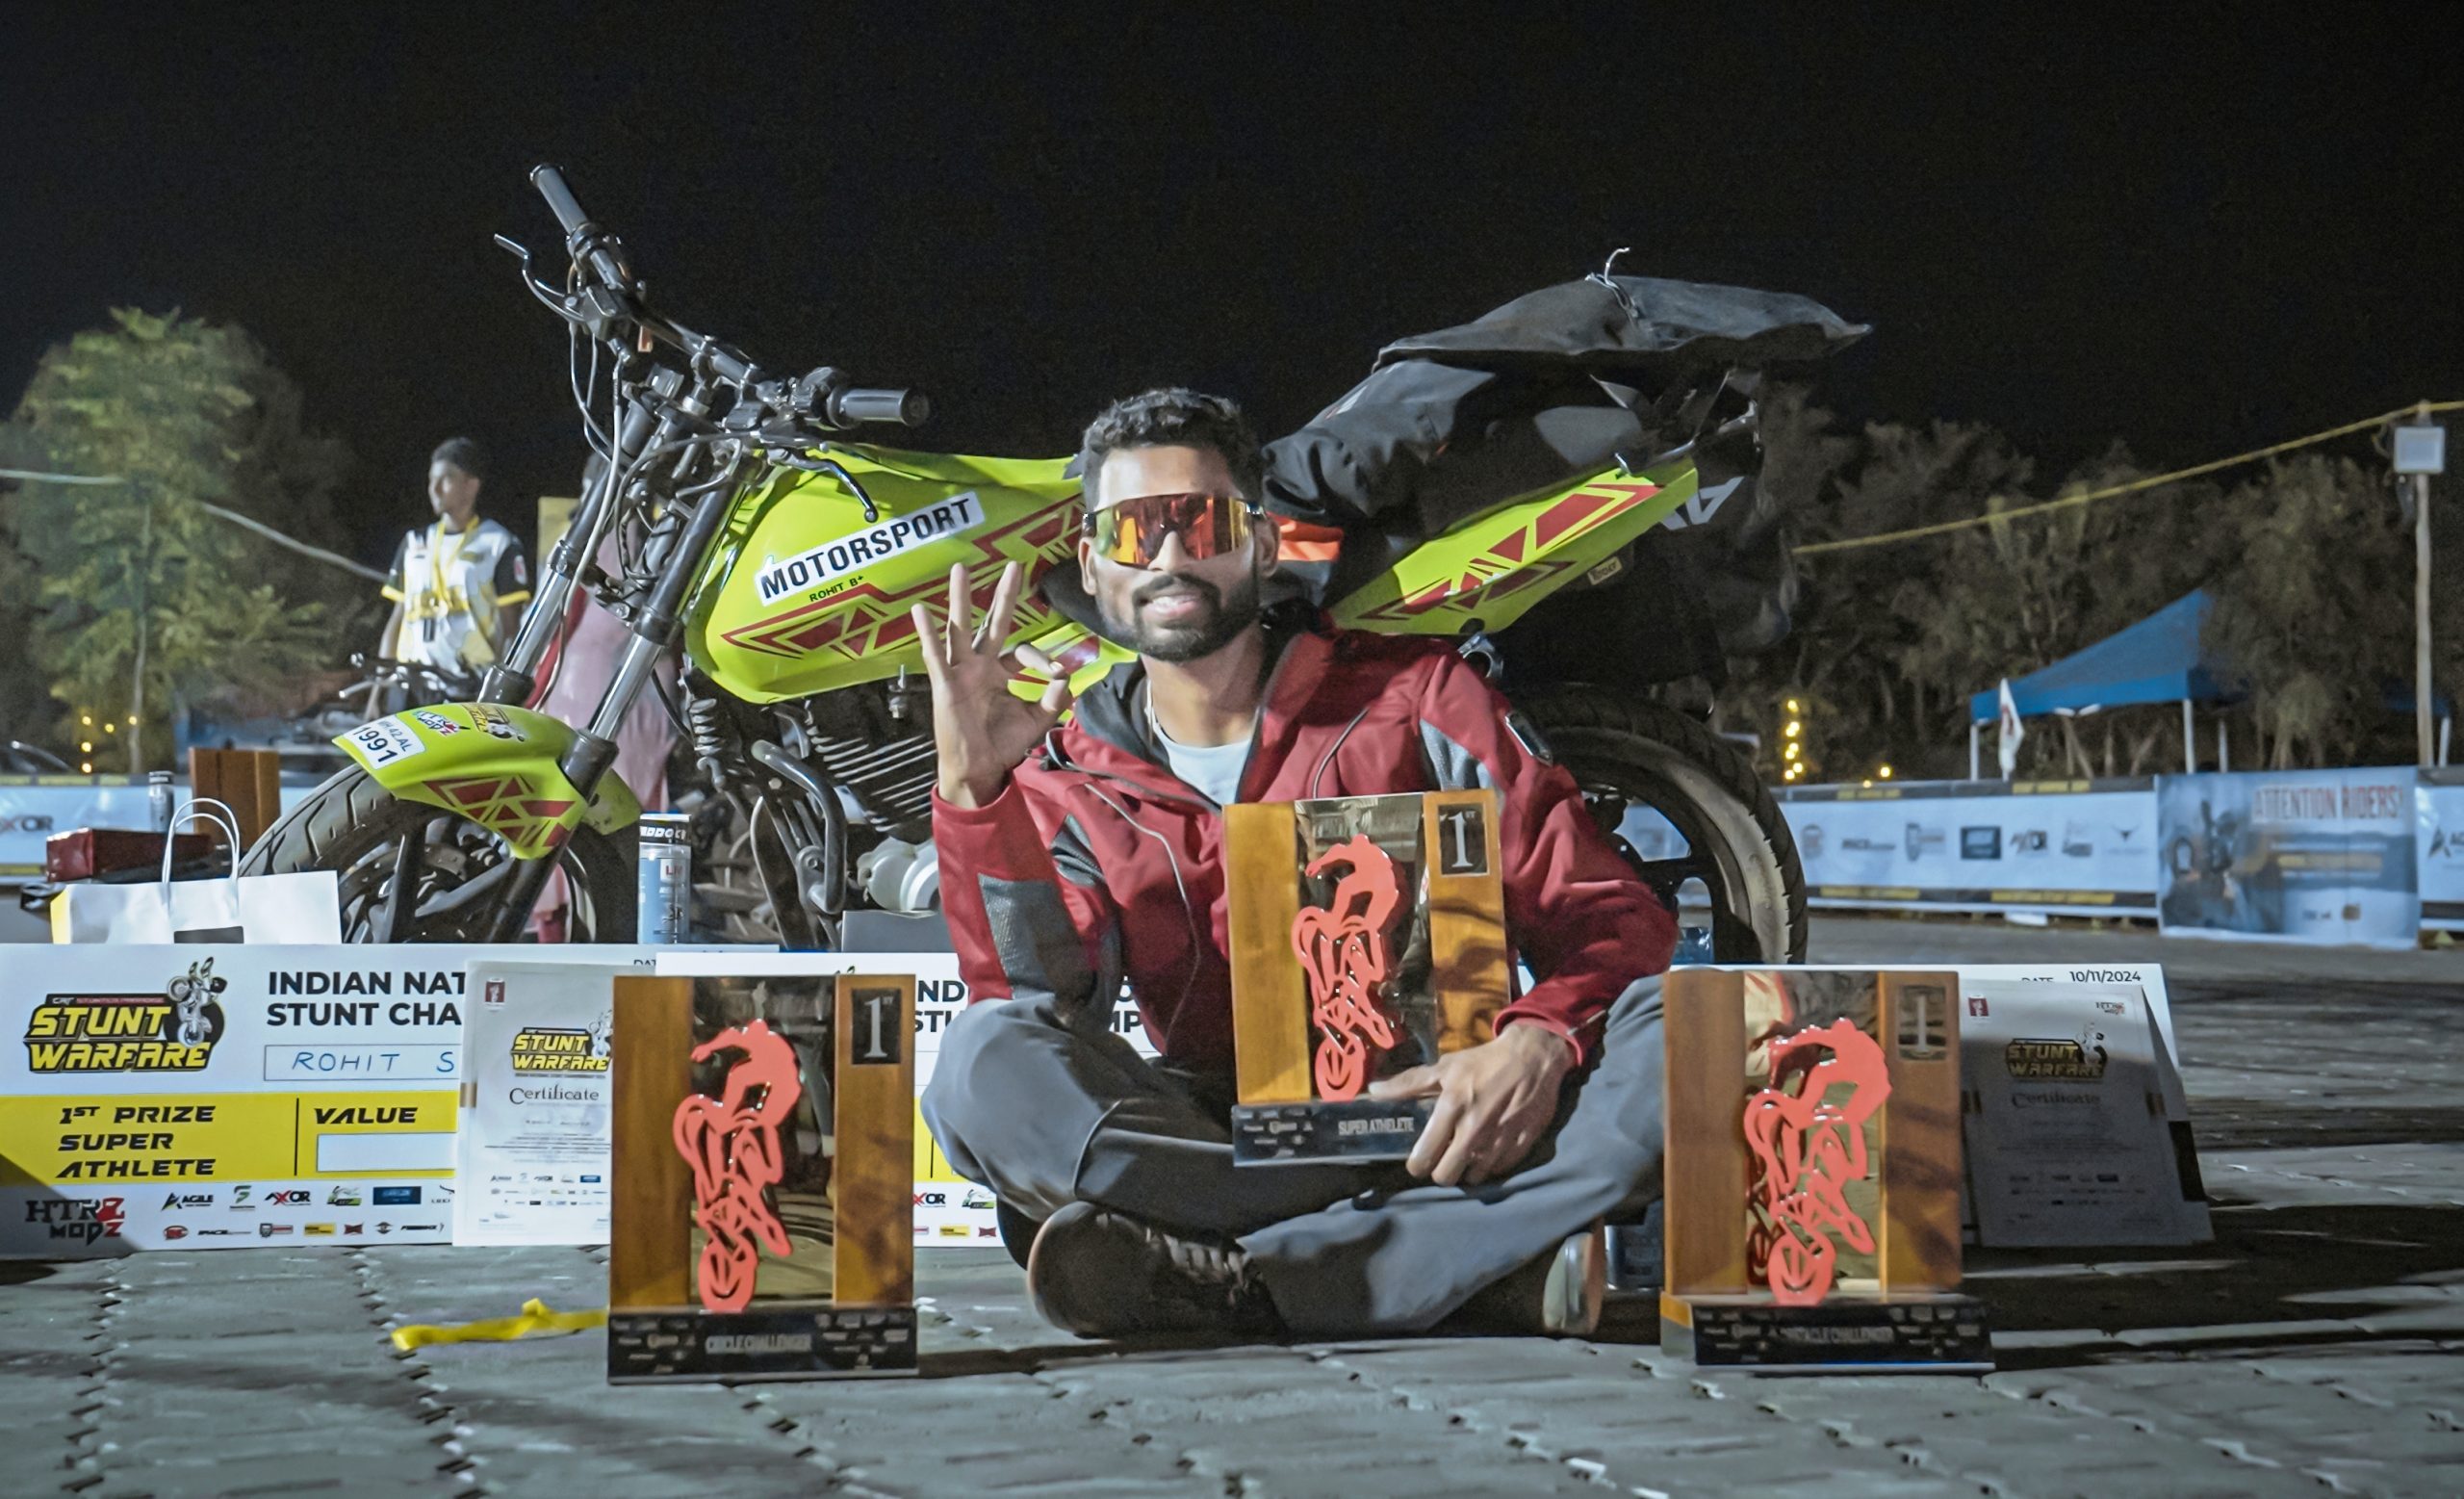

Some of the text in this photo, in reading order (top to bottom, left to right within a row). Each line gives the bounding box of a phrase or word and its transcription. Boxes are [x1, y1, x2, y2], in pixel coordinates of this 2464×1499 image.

[760, 498, 970, 599] MOTORSPORT
[809, 582, 844, 603] ROHIT
[353, 727, 398, 762] 1991
[269, 971, 467, 995] INDIAN NAT
[2069, 969, 2142, 983] 10/11/2024
[30, 1006, 171, 1036] STUNT
[266, 1002, 462, 1027] STUNT CHA
[513, 1034, 589, 1052] STUNT
[2008, 1045, 2079, 1060] STUNT
[30, 1042, 211, 1070] WARFARE
[292, 1051, 400, 1073] ROHIT
[513, 1055, 609, 1071] WARFARE
[2010, 1061, 2102, 1077] WARFARE
[509, 1083, 600, 1105] Certificate
[60, 1106, 216, 1124] 1ST PRIZE
[314, 1107, 419, 1124] VALUE
[58, 1133, 174, 1151] SUPER
[55, 1158, 217, 1178] ATHLETE
[182, 1195, 214, 1203] AGILE
[265, 1190, 311, 1205] AXOR
[49, 1221, 124, 1246] MODZ
